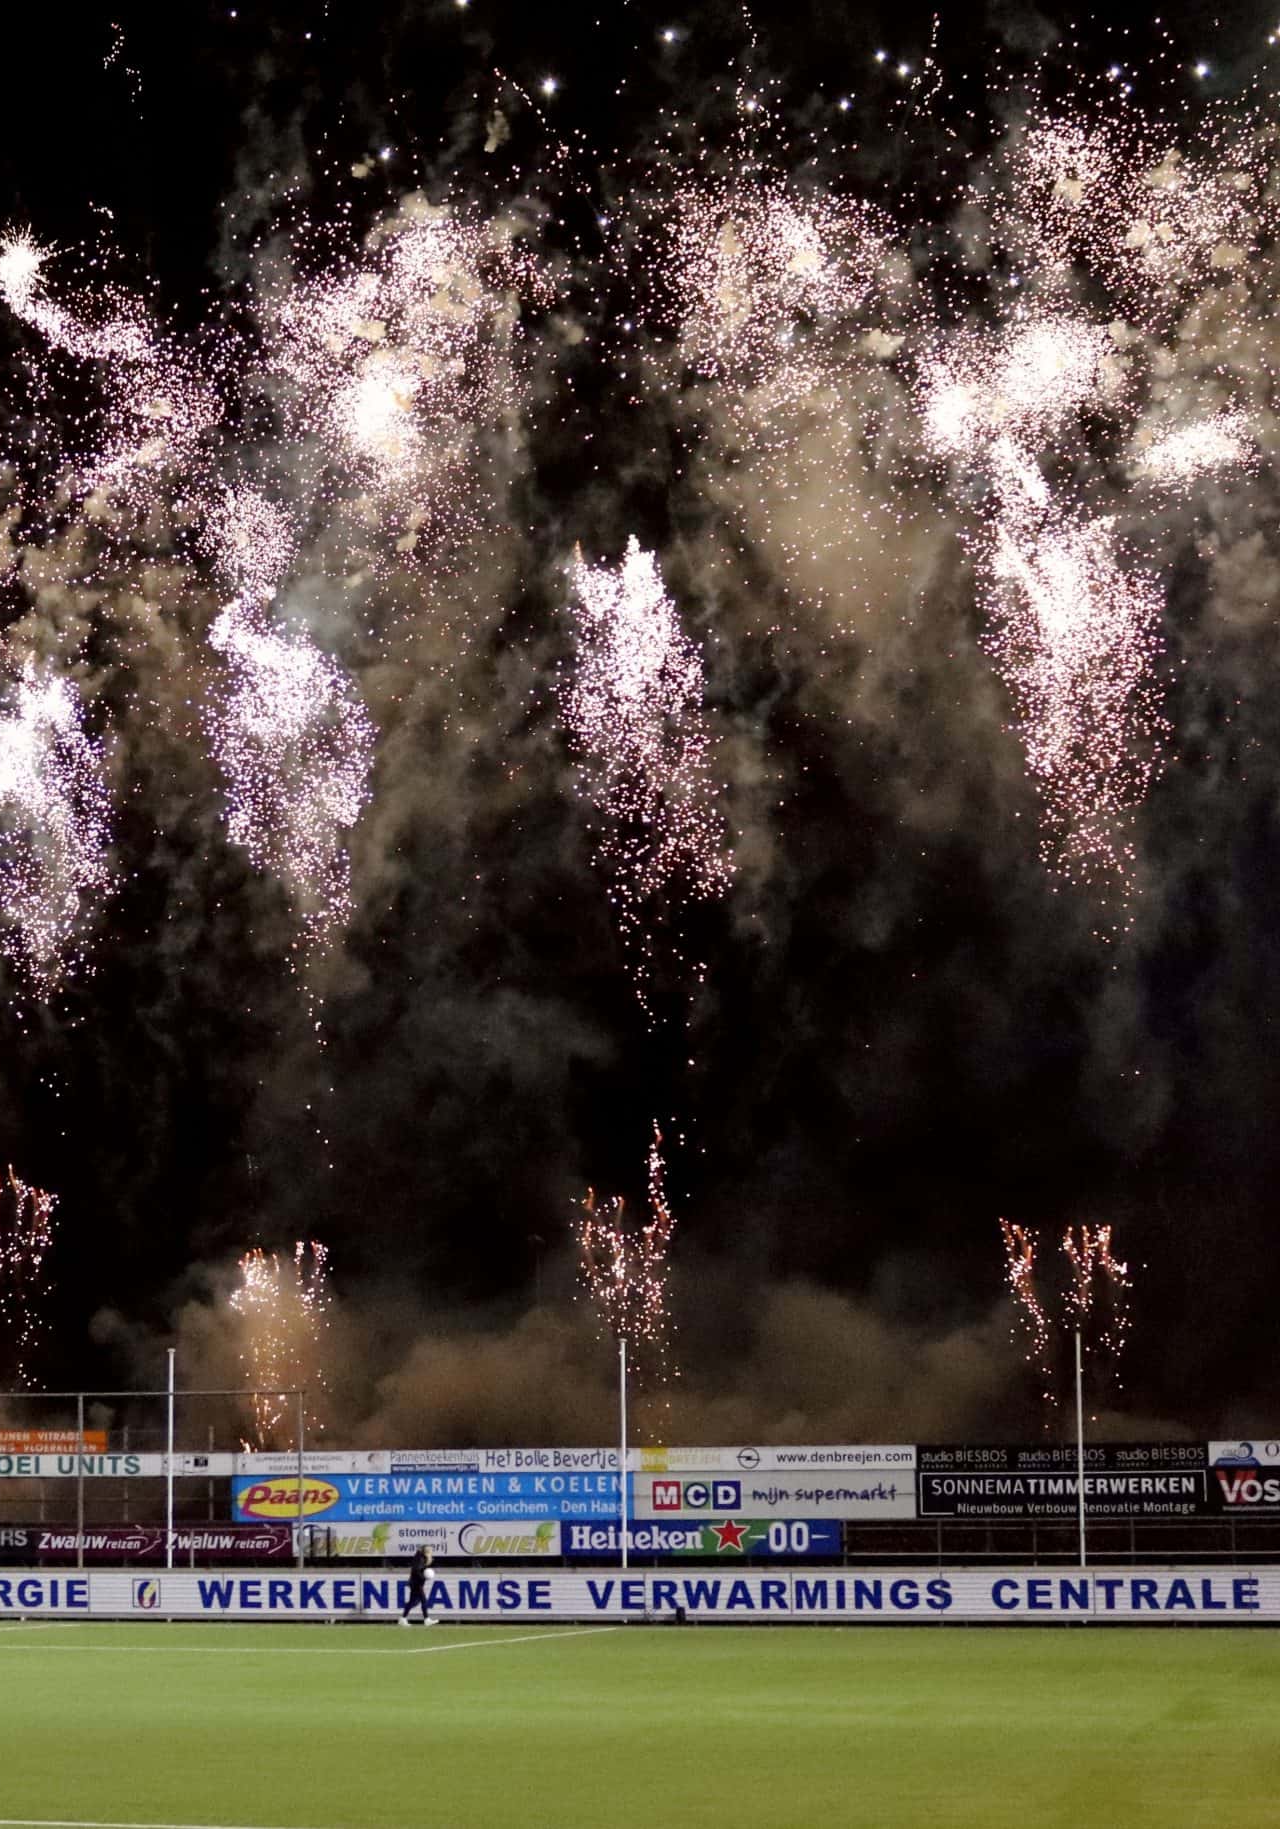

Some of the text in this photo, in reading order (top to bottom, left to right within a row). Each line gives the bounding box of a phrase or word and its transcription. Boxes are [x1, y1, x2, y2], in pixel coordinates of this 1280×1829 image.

[485, 1449, 617, 1469] Het Bolle Bevertje
[776, 1450, 913, 1465] www.denbreejen.com
[921, 1450, 1007, 1463] studio BIESBOS
[1017, 1450, 1050, 1462] studio
[1116, 1448, 1205, 1461] studio BIESBOS
[57, 1454, 141, 1475] UNITS
[347, 1476, 625, 1495] VERWARMEN & KOELEN
[751, 1483, 897, 1505] mijn supermarkt
[931, 1477, 1195, 1496] SONNEMA TIMMERWERKEN
[1220, 1479, 1280, 1503] VOS
[241, 1485, 333, 1516] Paans
[349, 1501, 405, 1515] Leerdam
[417, 1501, 465, 1515] Utrecht
[477, 1500, 548, 1514] Gorinchem
[561, 1500, 588, 1513] Den
[592, 1500, 624, 1516] Haag
[957, 1502, 1196, 1515] Nieuwbouw Verbouw Renovatie Montage
[38, 1533, 141, 1550] Zwaluw reizen
[165, 1532, 270, 1550] Zwaluw reizen
[398, 1527, 447, 1539] stomerij
[570, 1525, 704, 1550] Heineken
[197, 1578, 1261, 1611] WERKENDAMSE VERWARMINGS CENTRALE
